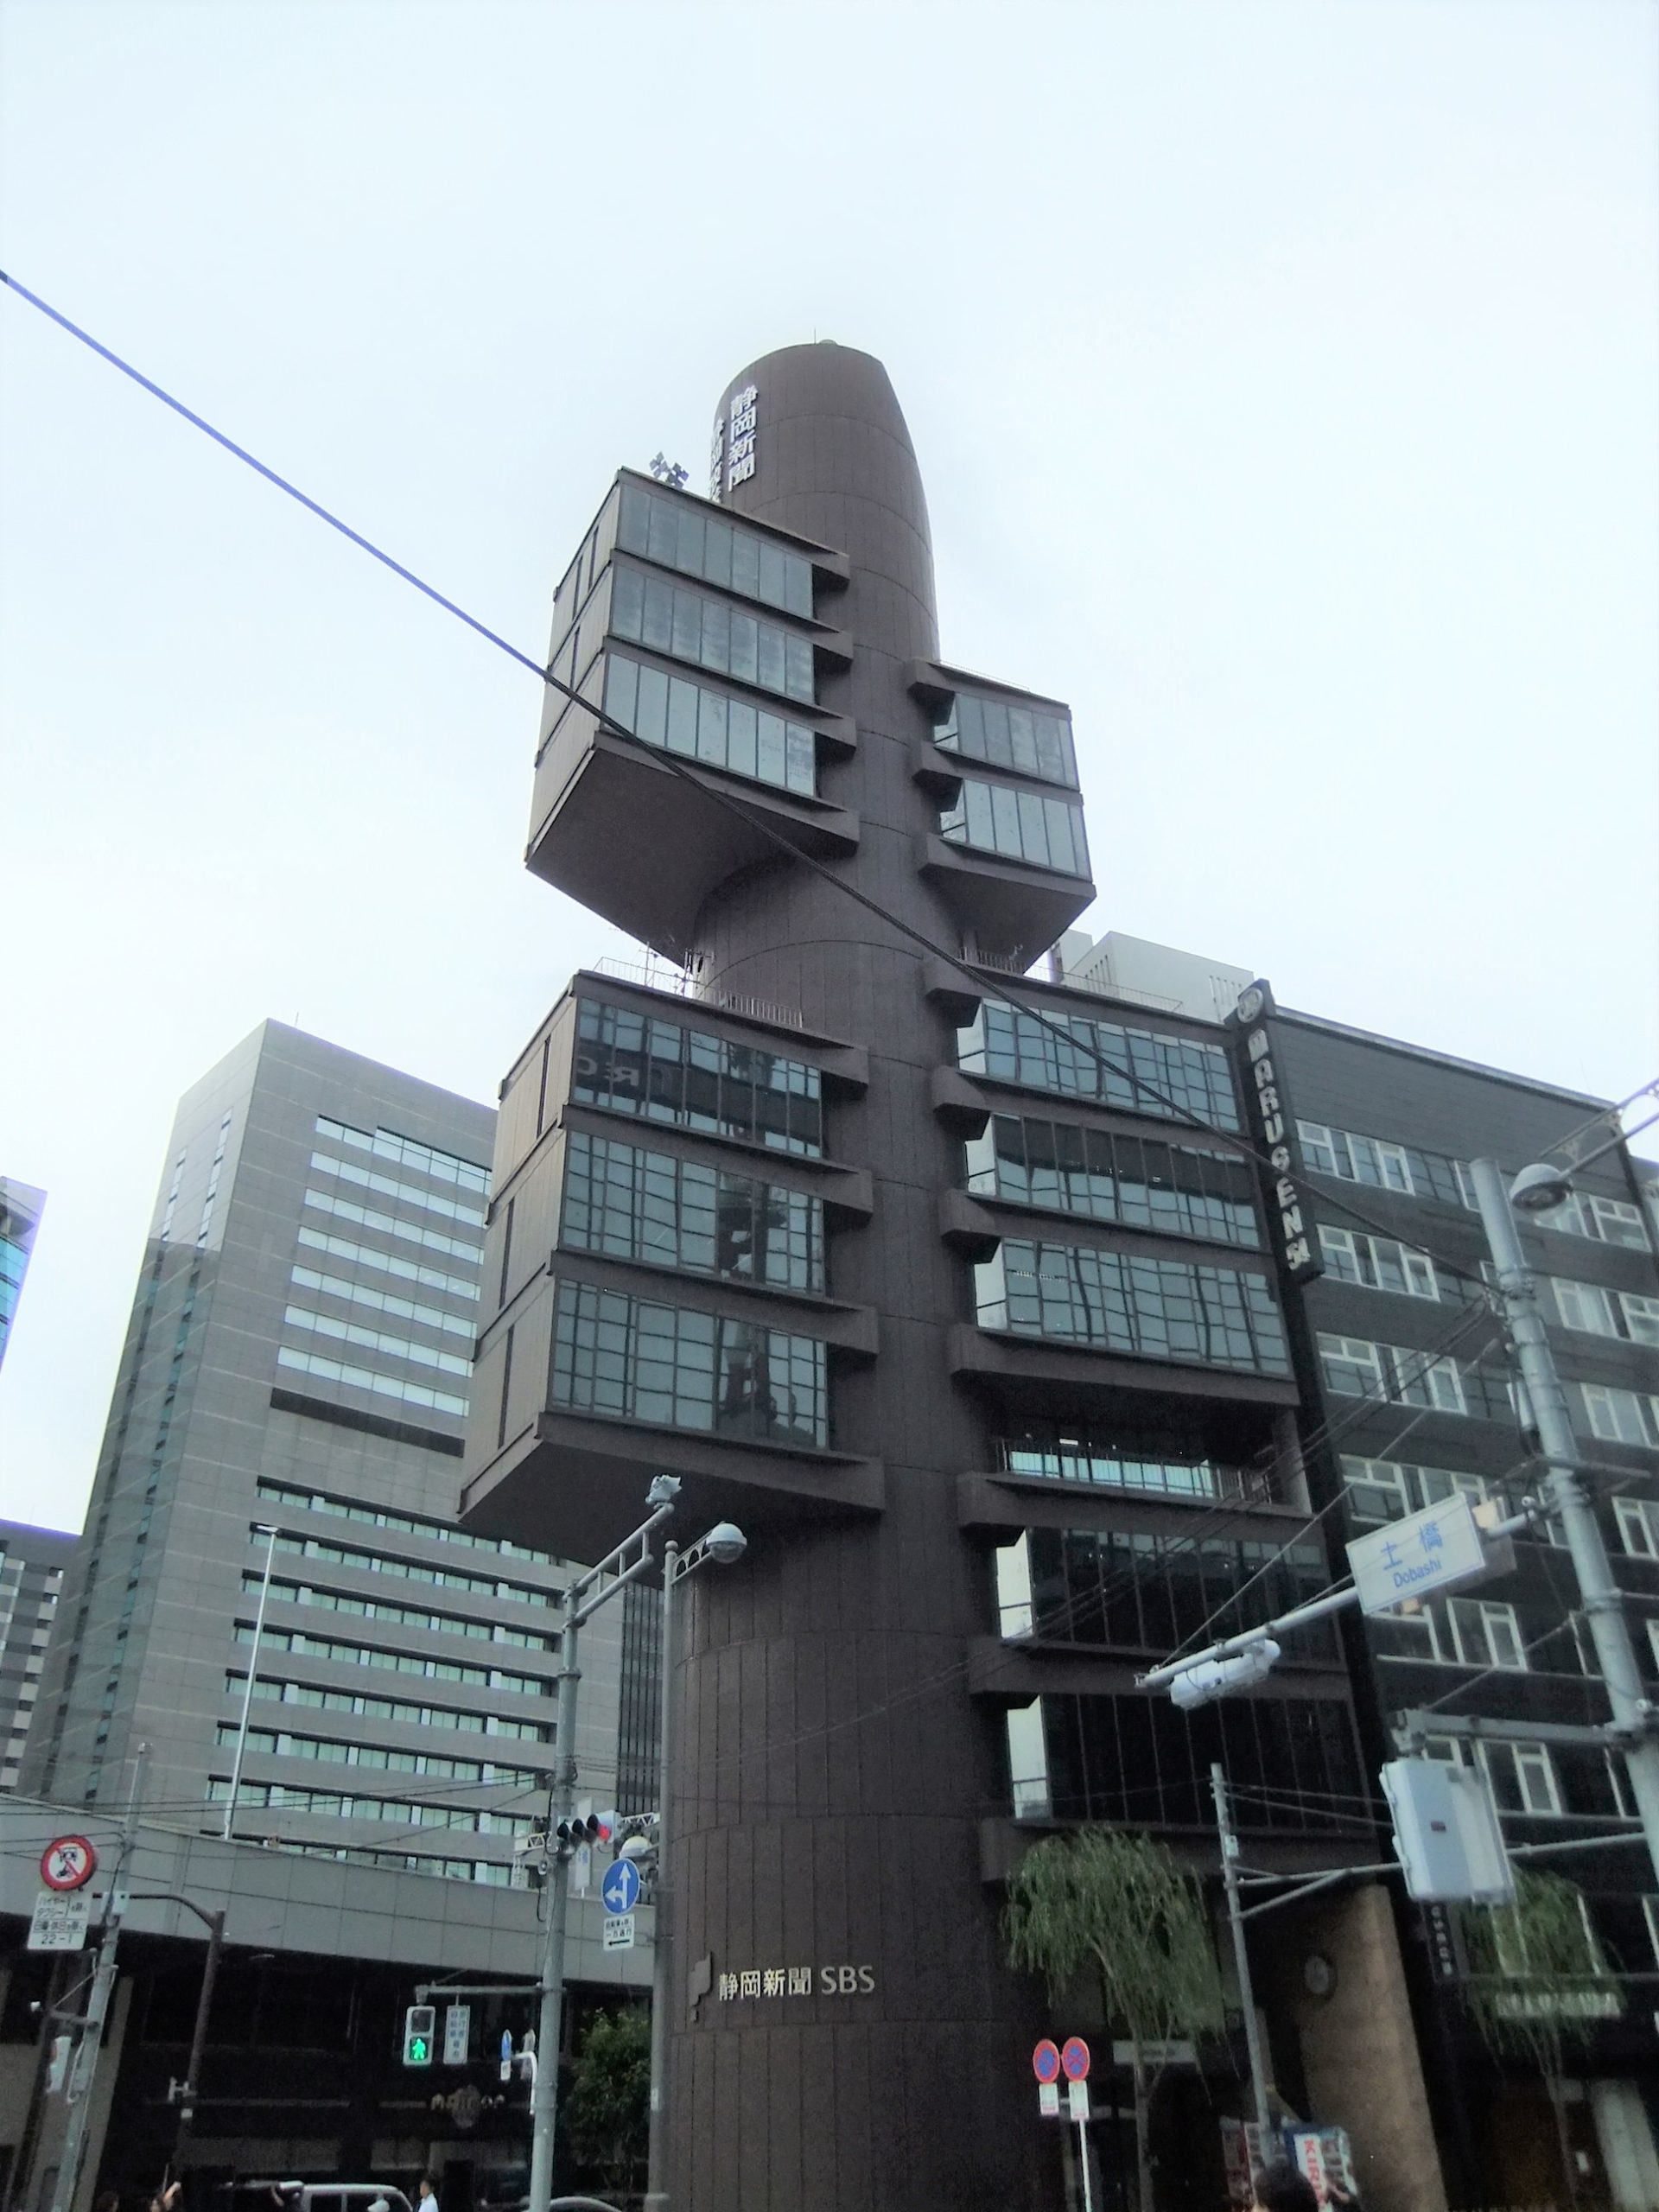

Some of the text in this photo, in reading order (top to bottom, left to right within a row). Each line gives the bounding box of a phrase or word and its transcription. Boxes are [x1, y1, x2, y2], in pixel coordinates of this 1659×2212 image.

[728, 385, 758, 492] 静岡新聞
[1248, 1028, 1303, 1239] MARUGEN
[1380, 1520, 1443, 1571] 土橋
[1392, 1560, 1442, 1588] Dobashi
[719, 1965, 876, 2001] 静岡新聞 SBS
